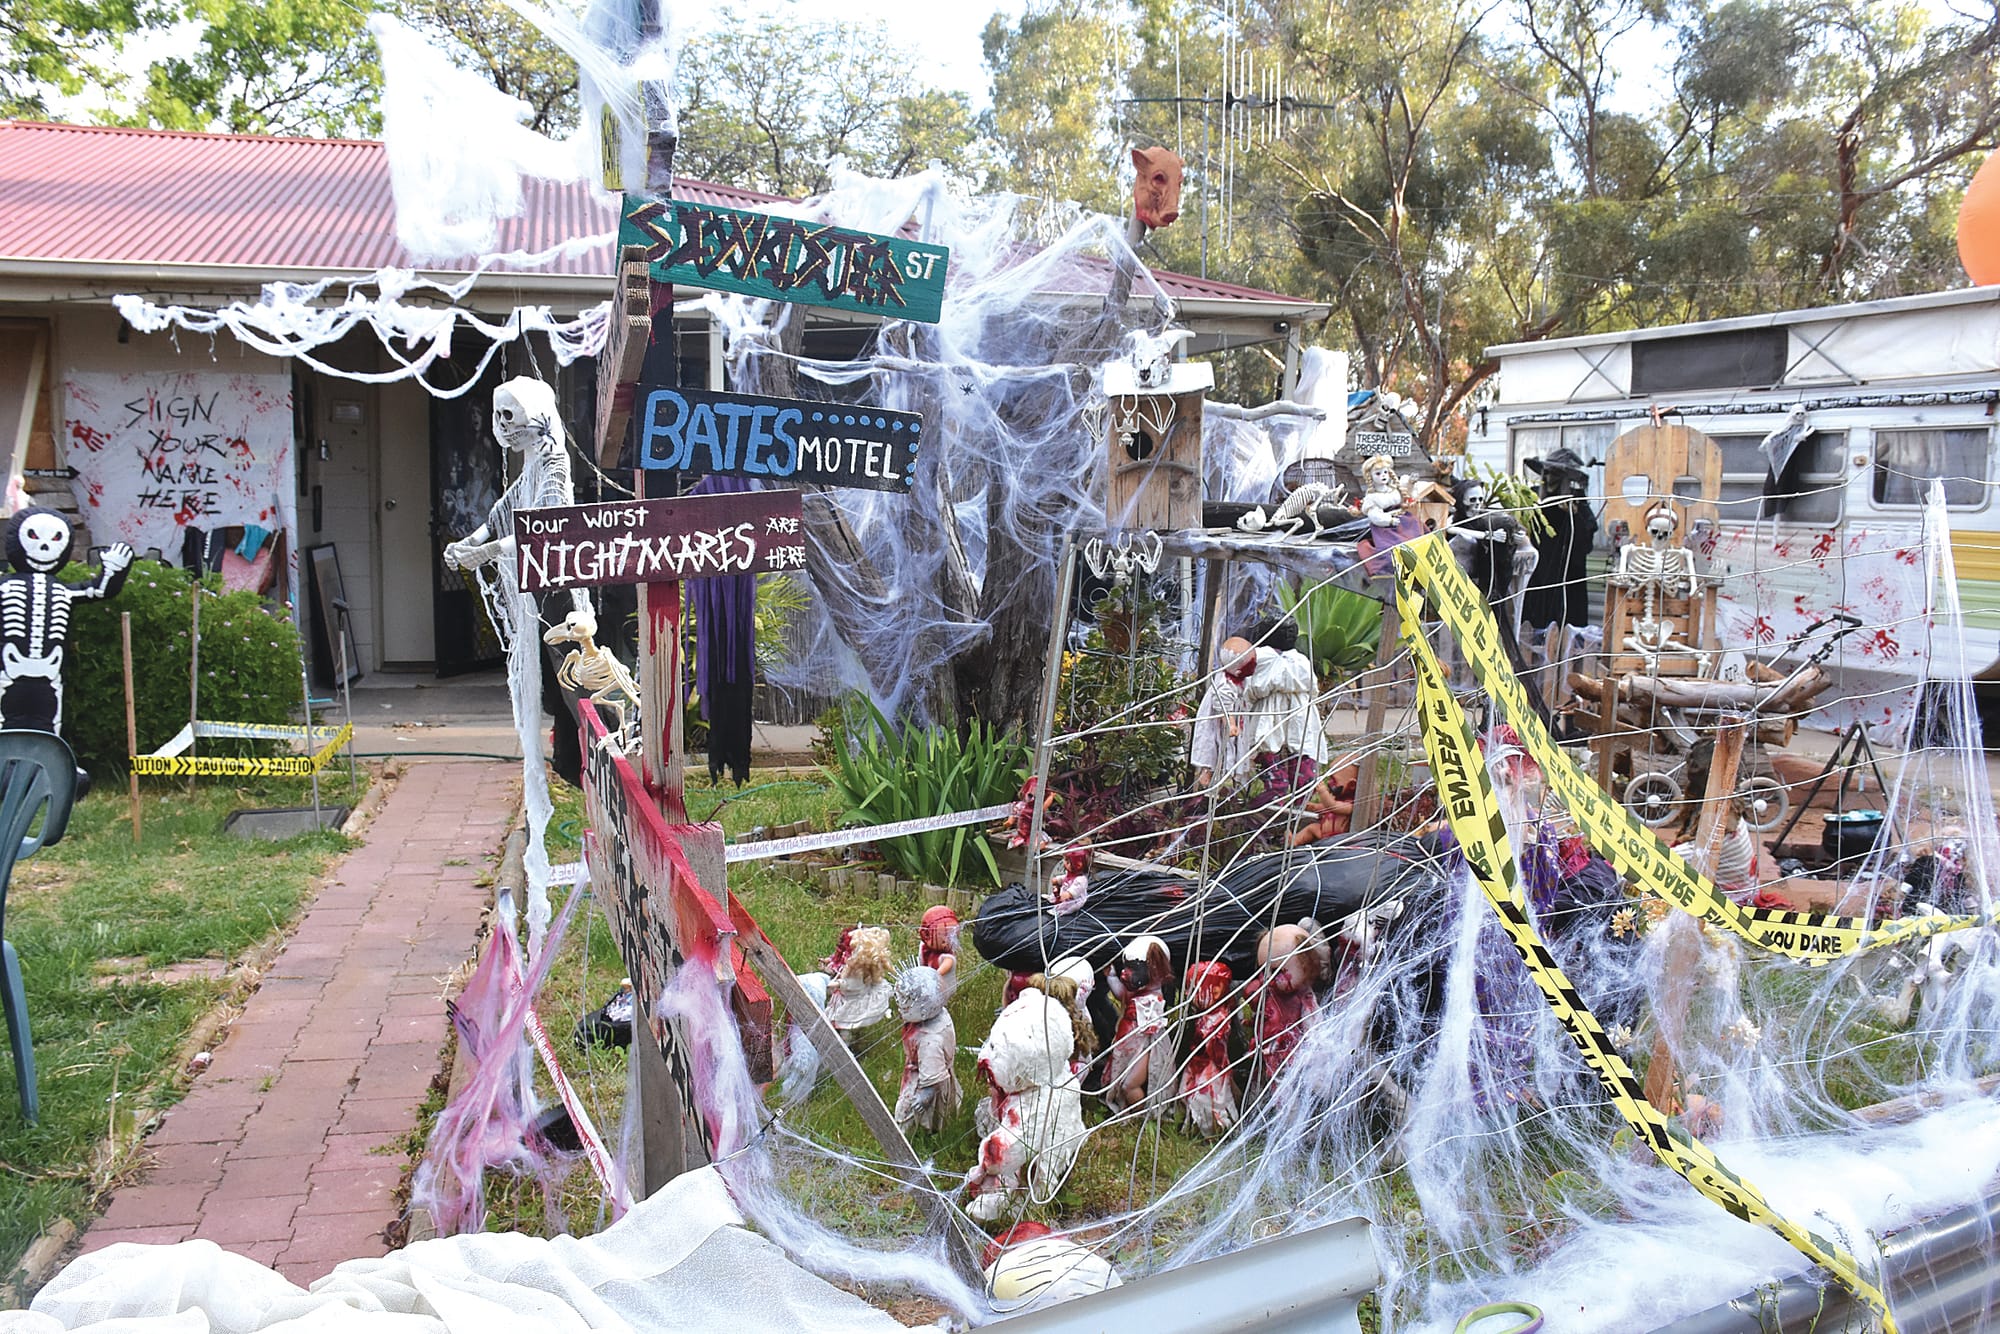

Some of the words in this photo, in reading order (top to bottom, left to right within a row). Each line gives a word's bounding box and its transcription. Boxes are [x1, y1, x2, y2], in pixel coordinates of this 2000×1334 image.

[906, 250, 941, 280] ST
[124, 391, 219, 428] SIGN
[148, 430, 227, 457] YOUR
[640, 389, 803, 476] BATES
[797, 436, 900, 480] MOTEL
[1356, 443, 1410, 454] PROSECUTED
[139, 452, 219, 485] NAME
[137, 489, 222, 515] HERE
[519, 514, 569, 535] Your
[765, 516, 800, 536] ARE
[520, 522, 756, 590] NIGHTMARES
[764, 545, 807, 569] HERE
[130, 758, 172, 773] AUTION
[195, 758, 245, 774] CAUTION
[1800, 932, 1843, 954] DARE
